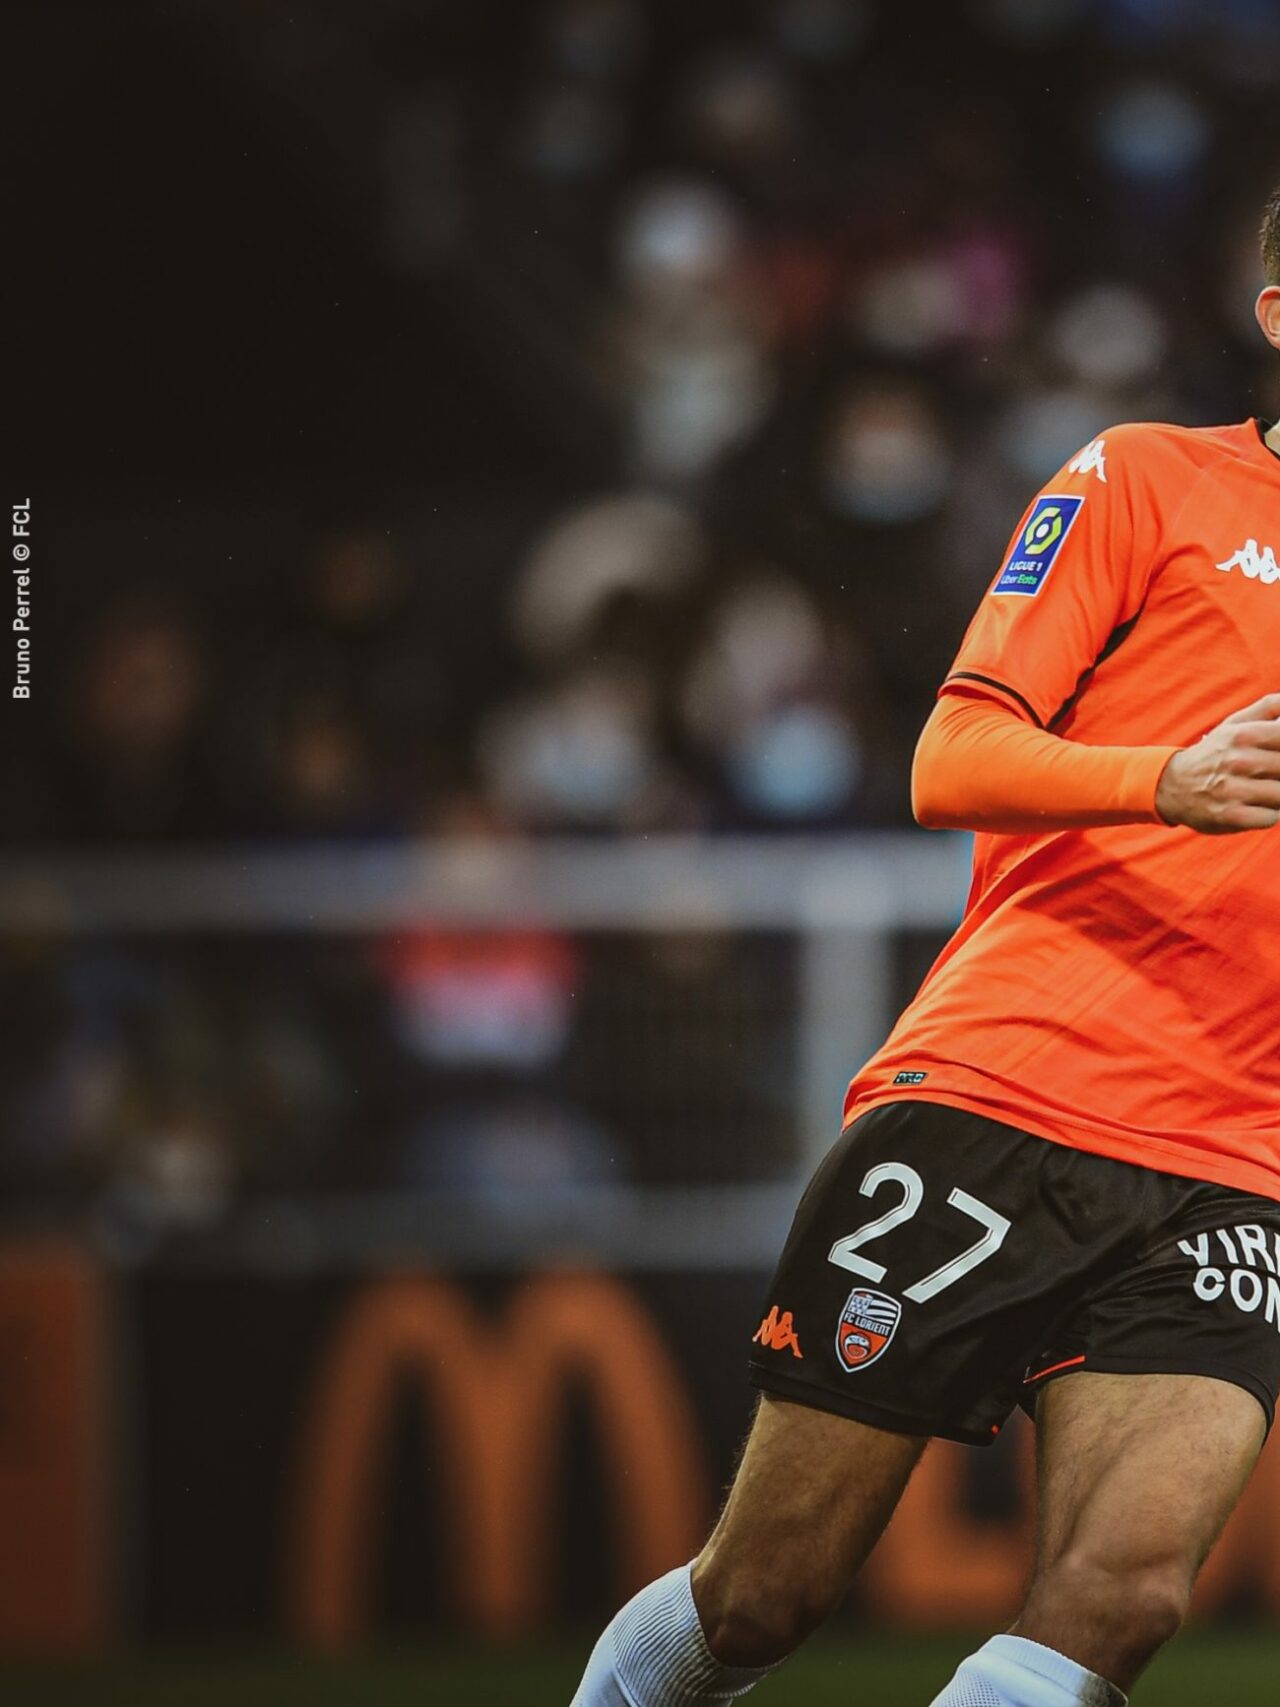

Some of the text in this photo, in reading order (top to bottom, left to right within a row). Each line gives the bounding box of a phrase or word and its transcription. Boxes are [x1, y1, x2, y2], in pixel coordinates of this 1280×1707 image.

[1008, 561, 1037, 571] LIGUE
[827, 1161, 1012, 1304] 27
[843, 1312, 891, 1336] FC LORIENT
